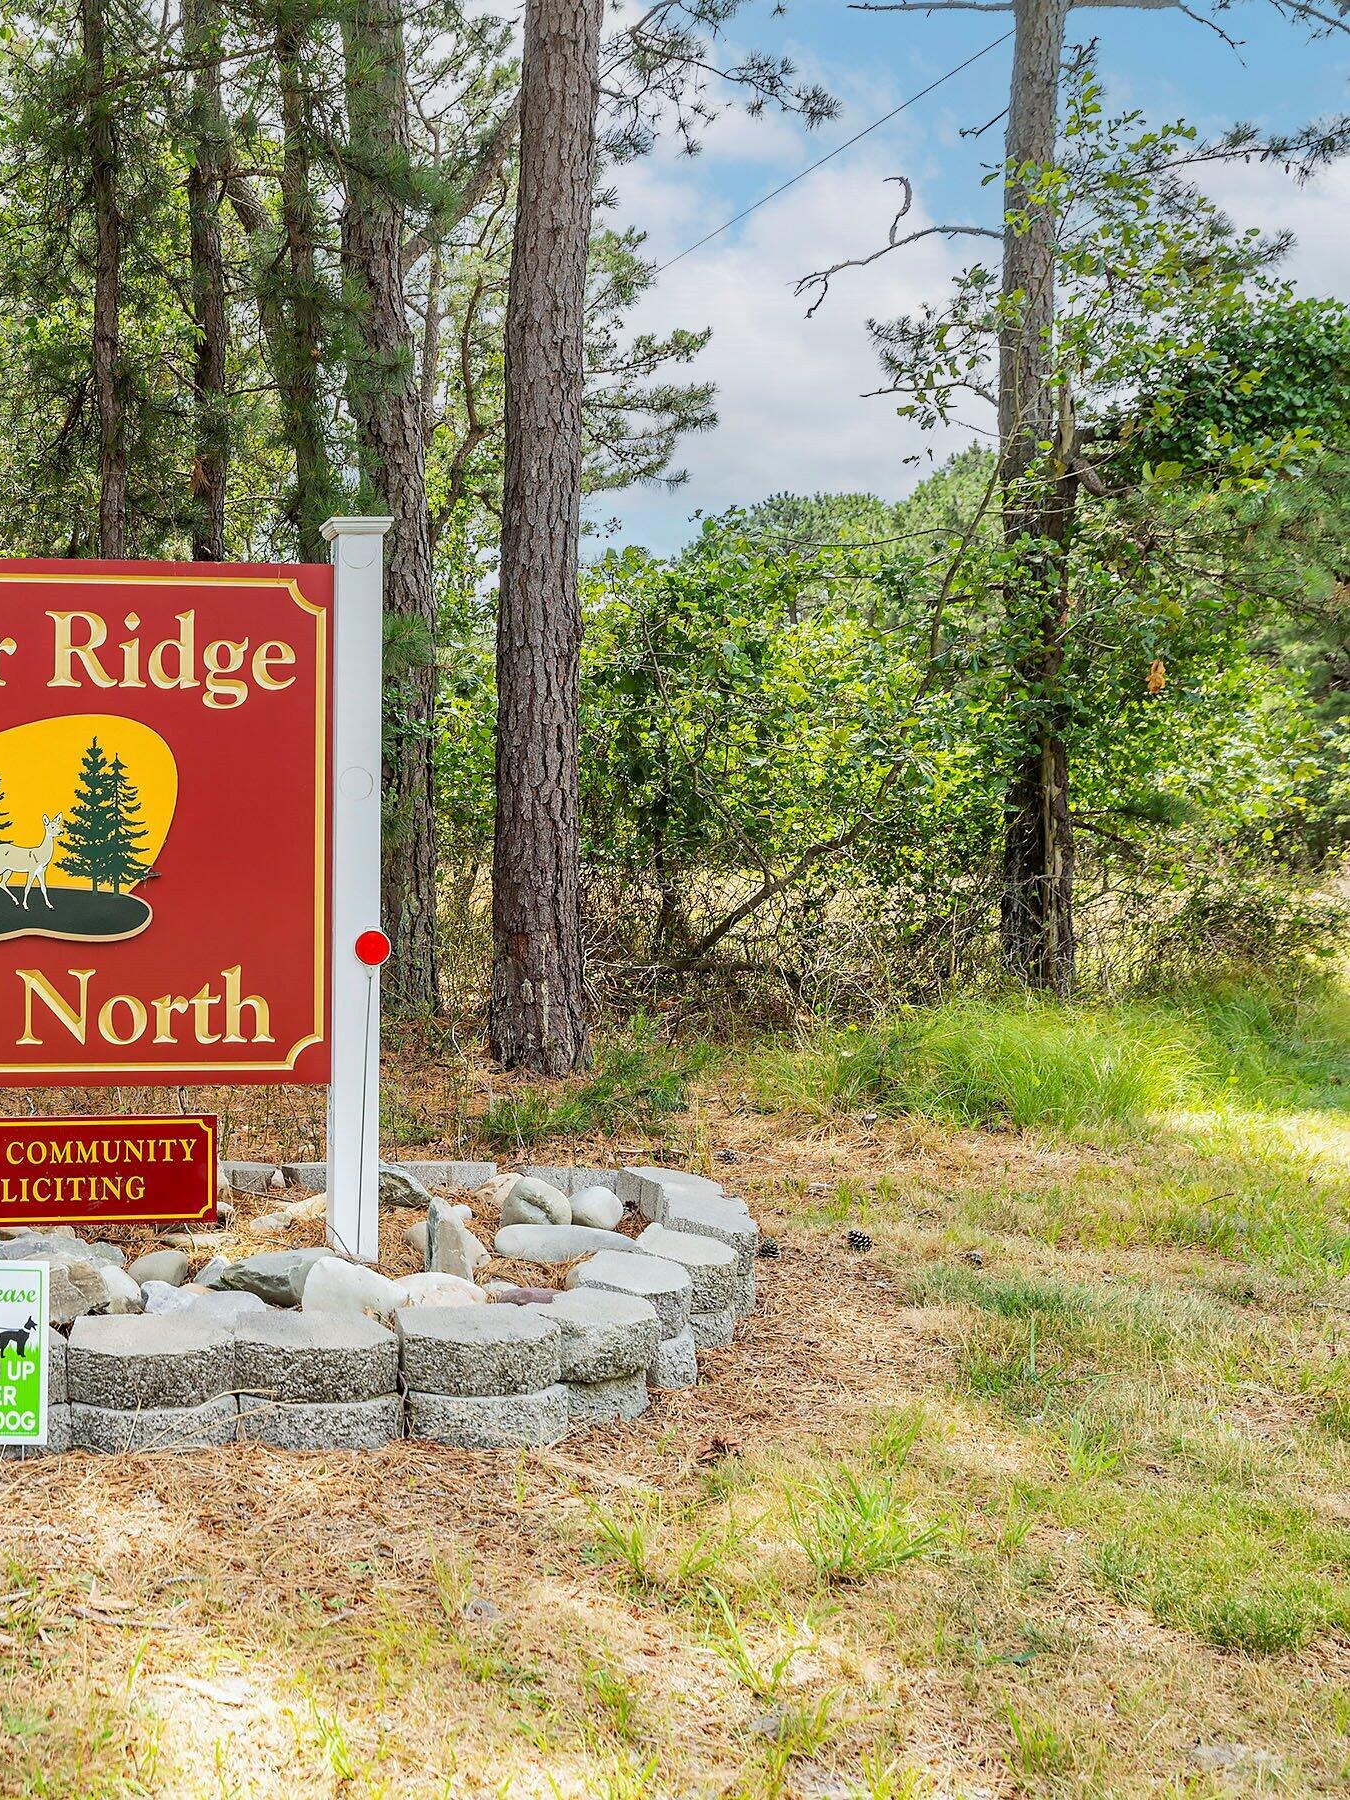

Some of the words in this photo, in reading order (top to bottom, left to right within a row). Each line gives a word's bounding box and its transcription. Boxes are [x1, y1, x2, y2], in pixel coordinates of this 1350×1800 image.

[44, 609, 298, 709] Ridge
[14, 965, 276, 1046] North
[6, 1138, 198, 1165] COMMUNITY
[7, 1360, 35, 1380] UP
